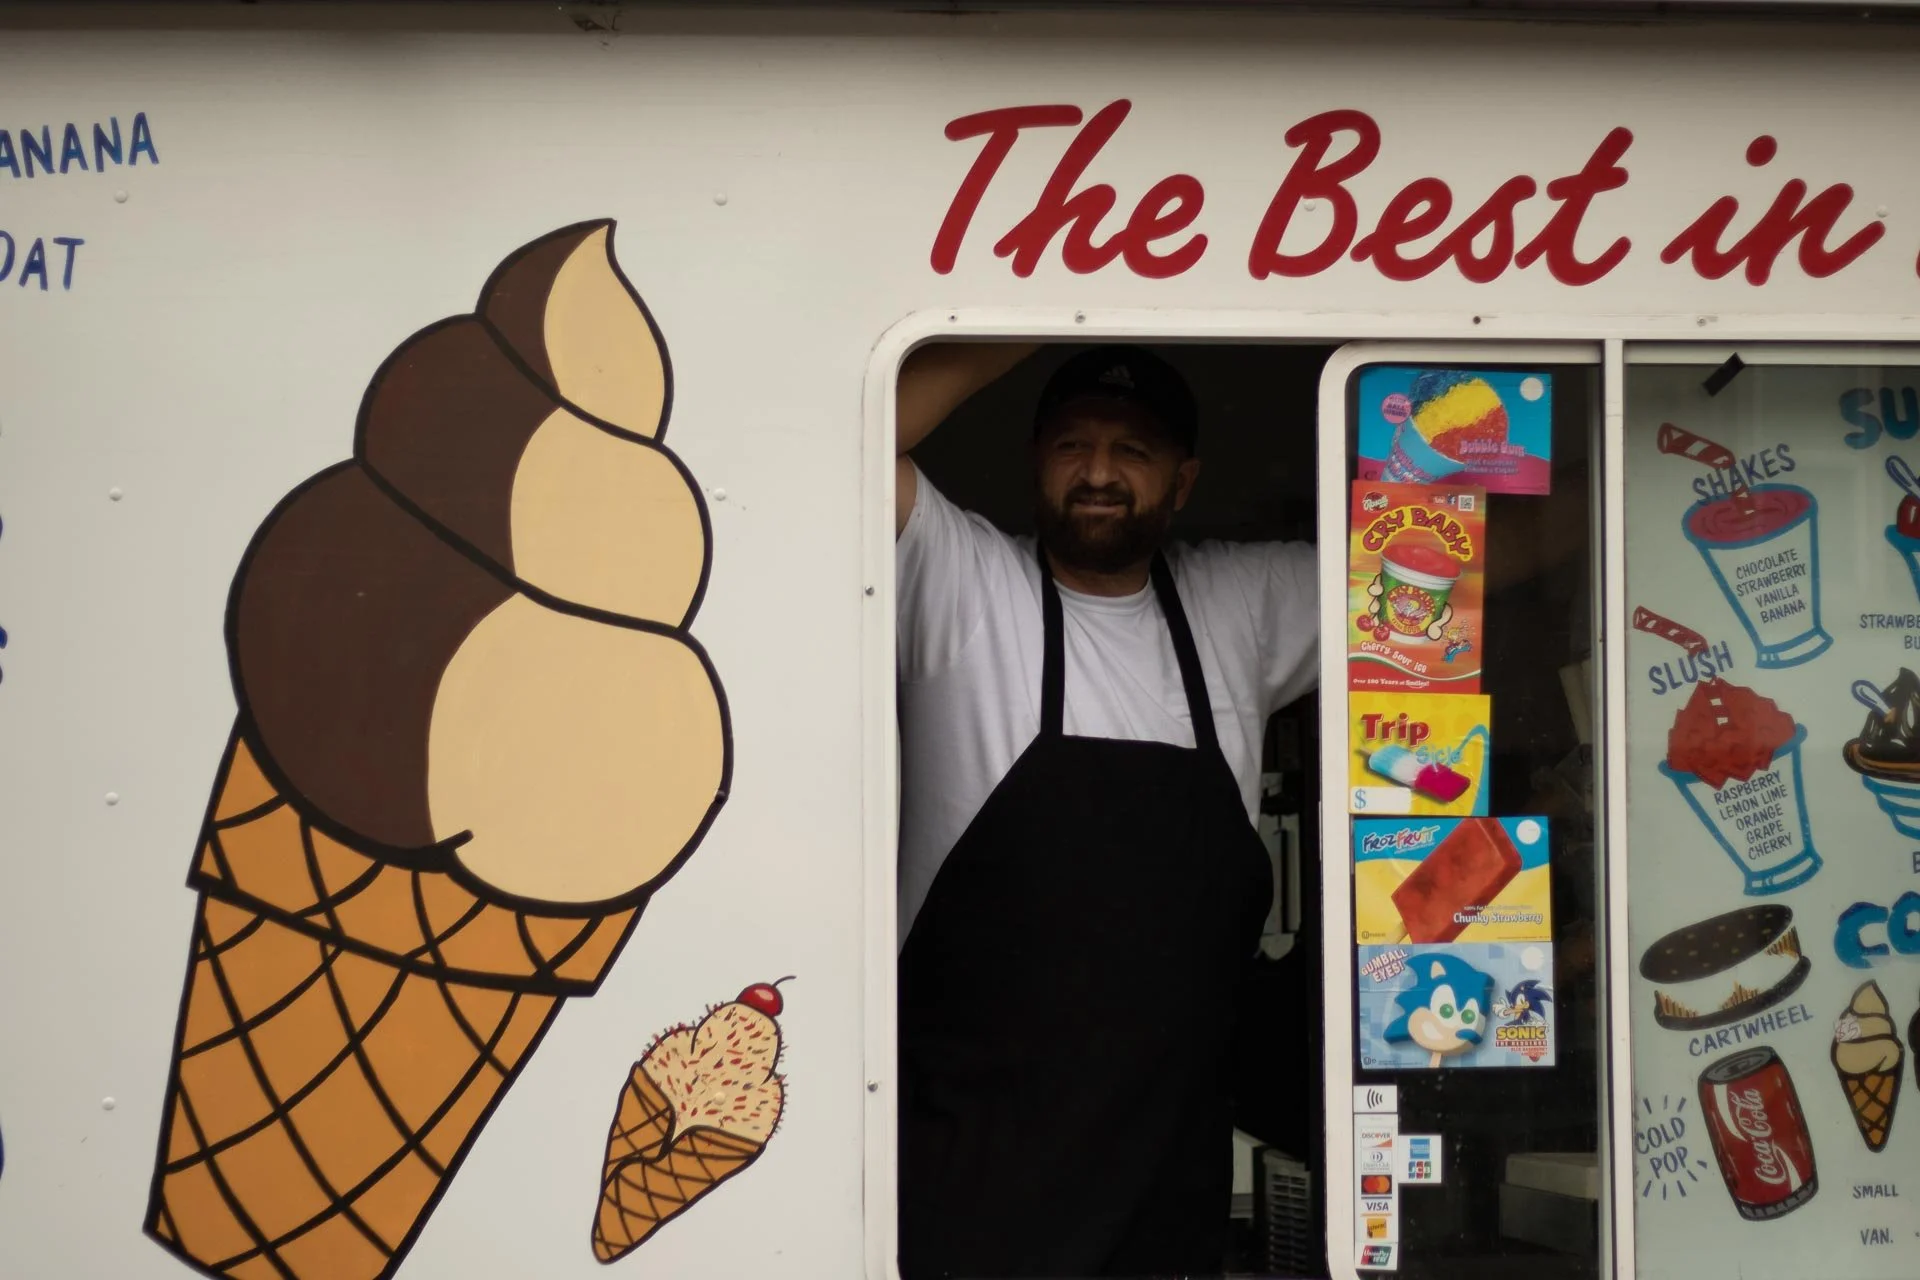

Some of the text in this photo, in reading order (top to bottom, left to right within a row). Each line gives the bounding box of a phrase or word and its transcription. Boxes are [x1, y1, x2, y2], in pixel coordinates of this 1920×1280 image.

[929, 98, 1887, 287] The Best in
[1839, 386, 1920, 450] SU
[1692, 443, 1797, 505] SHAKES
[1362, 507, 1472, 557] CRY BABY
[1736, 548, 1798, 580] CHOCOLATE
[1736, 563, 1806, 597] STRAWBERRY
[1755, 583, 1800, 608] VANILLA
[1760, 599, 1806, 624] BANANA
[1361, 641, 1391, 655] Cherry
[1392, 650, 1413, 666] Sour
[1380, 678, 1399, 686] Years
[1648, 640, 1734, 696] SLUSH
[1360, 712, 1432, 747] Trip
[1354, 788, 1366, 809] $
[1714, 770, 1781, 805] RASPBERRY
[1719, 784, 1788, 820] LEMON LIME
[1736, 803, 1784, 831] ORANGE
[1746, 820, 1784, 844] GRAPE
[1748, 831, 1793, 860] CHERRY
[1453, 911, 1543, 925] Chunky Strawberry
[1361, 949, 1408, 976] GUMBALL
[1372, 960, 1405, 984] EYES!
[1496, 1025, 1547, 1041] SONIC
[1688, 1003, 1814, 1057] CARTWHEEL
[1634, 1116, 1686, 1155] COLD
[1649, 1146, 1688, 1180] POP
[1852, 1183, 1900, 1200] SMALL
[1366, 1201, 1389, 1211] VISA
[1860, 1227, 1894, 1246] VAN.
